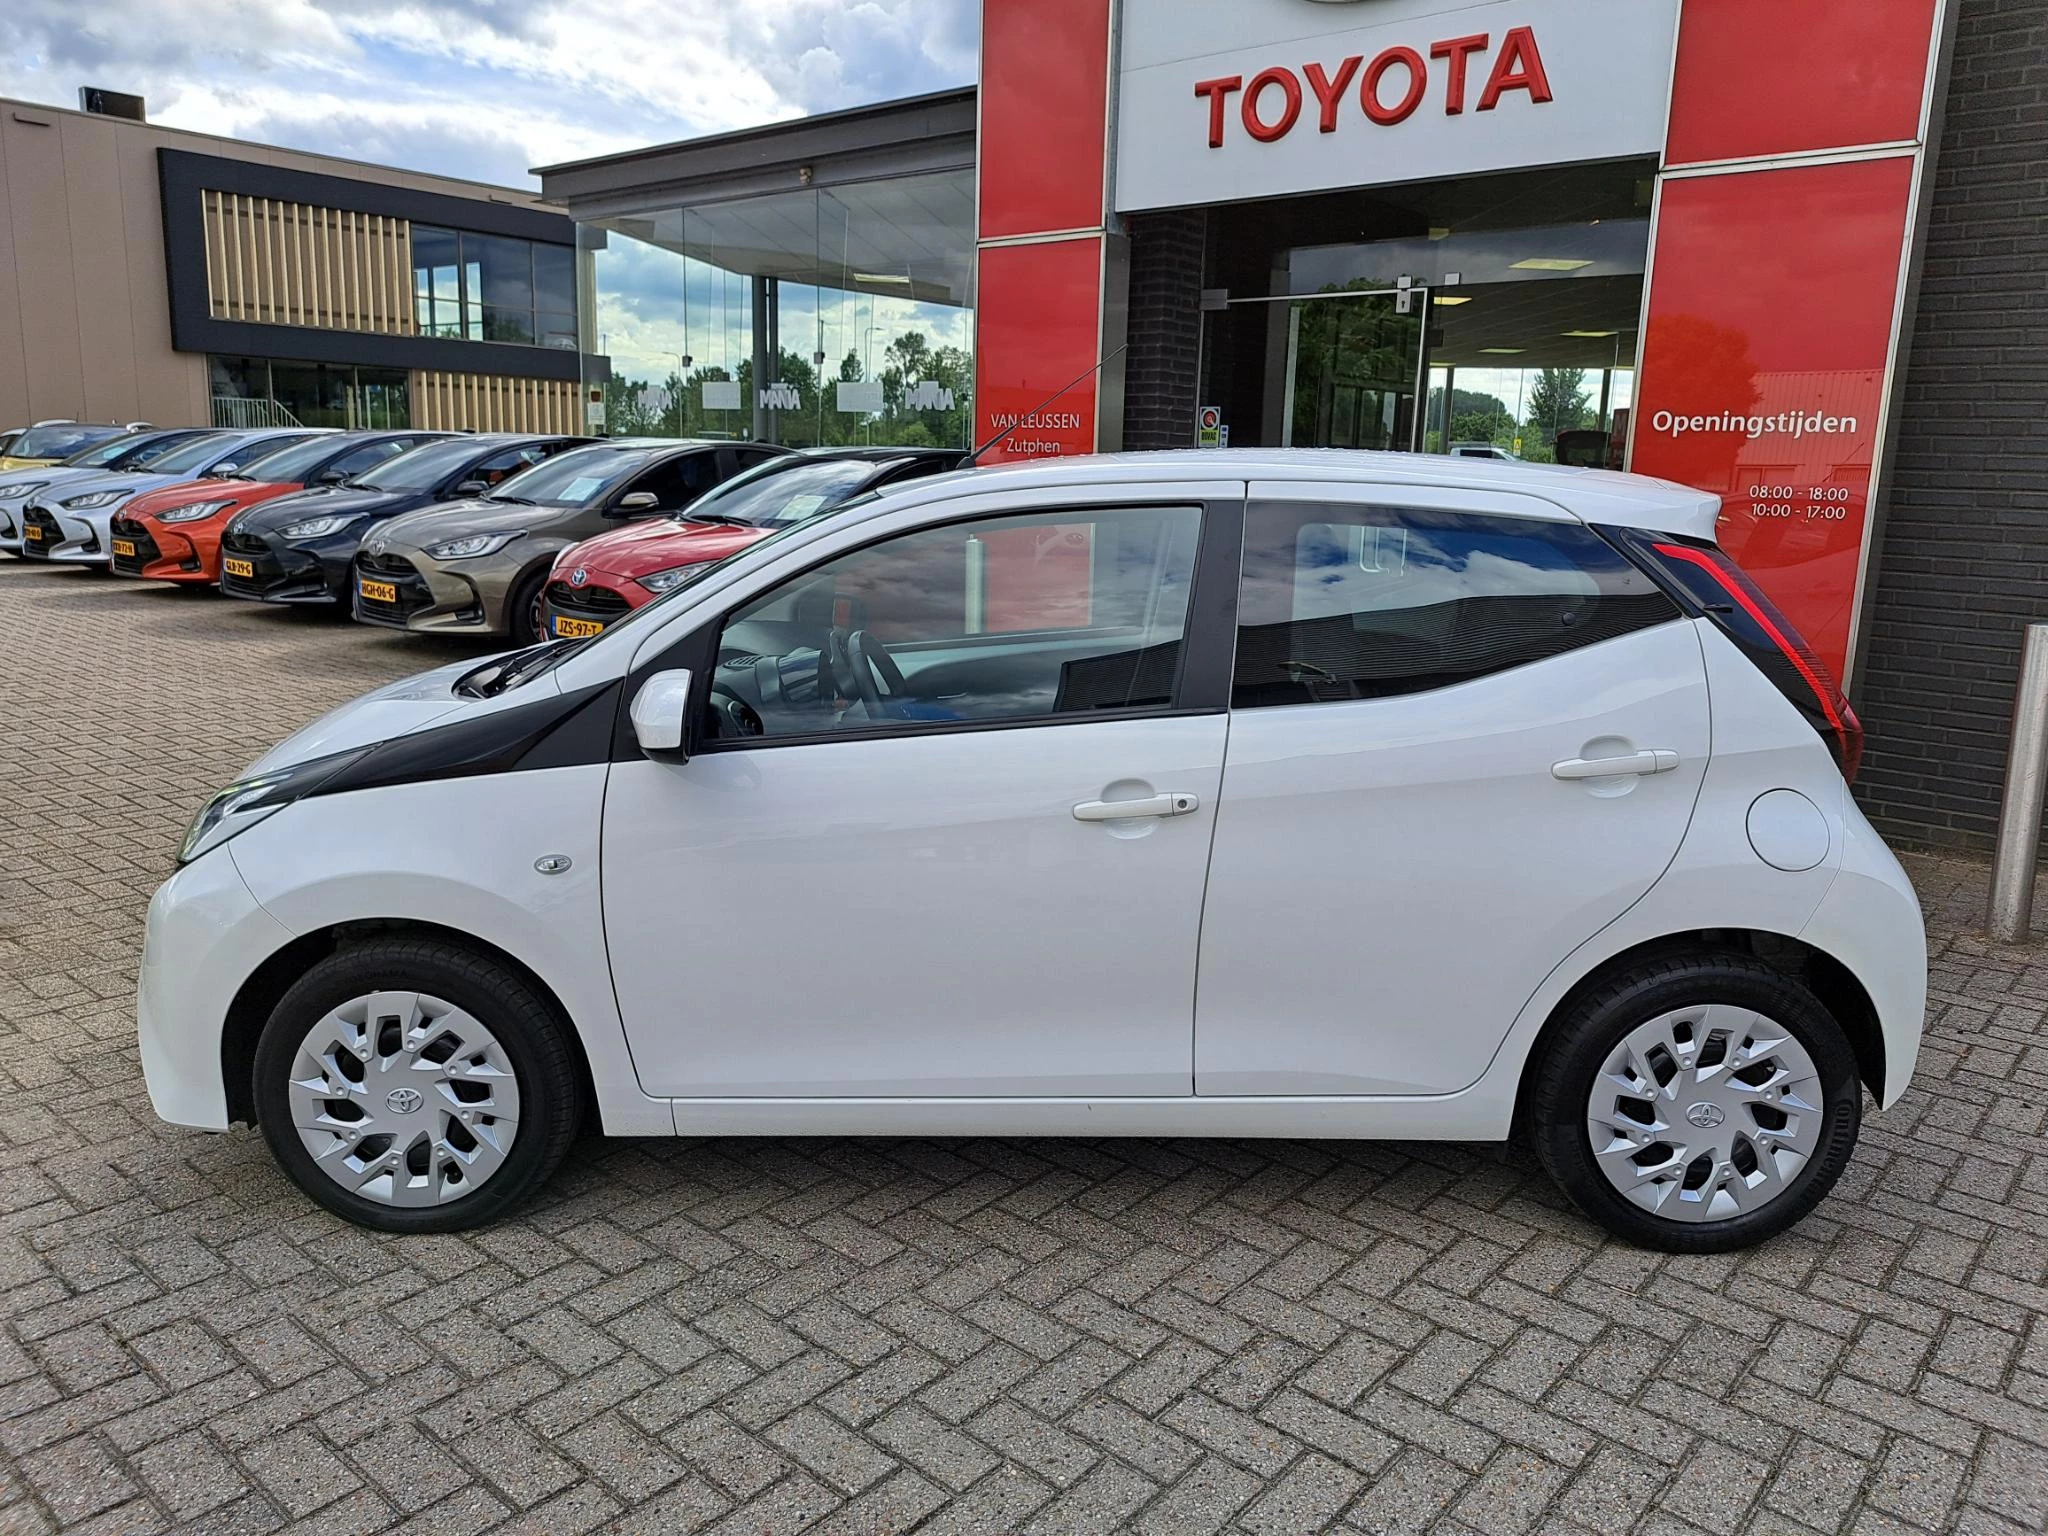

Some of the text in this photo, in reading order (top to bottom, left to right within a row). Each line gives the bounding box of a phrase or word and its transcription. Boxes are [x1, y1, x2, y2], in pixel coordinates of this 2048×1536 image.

[1195, 25, 1553, 148] TOYOTA
[991, 413, 1080, 428] VAN LEUSSEN
[1652, 410, 1857, 439] Openingstijden
[1007, 438, 1060, 455] Zutphen
[1750, 485, 1793, 499] 08:00
[1808, 487, 1849, 501] 18:00
[1751, 503, 1791, 517] 10:00
[1806, 505, 1846, 520] 17:00
[559, 619, 597, 636] JZS-97-T
